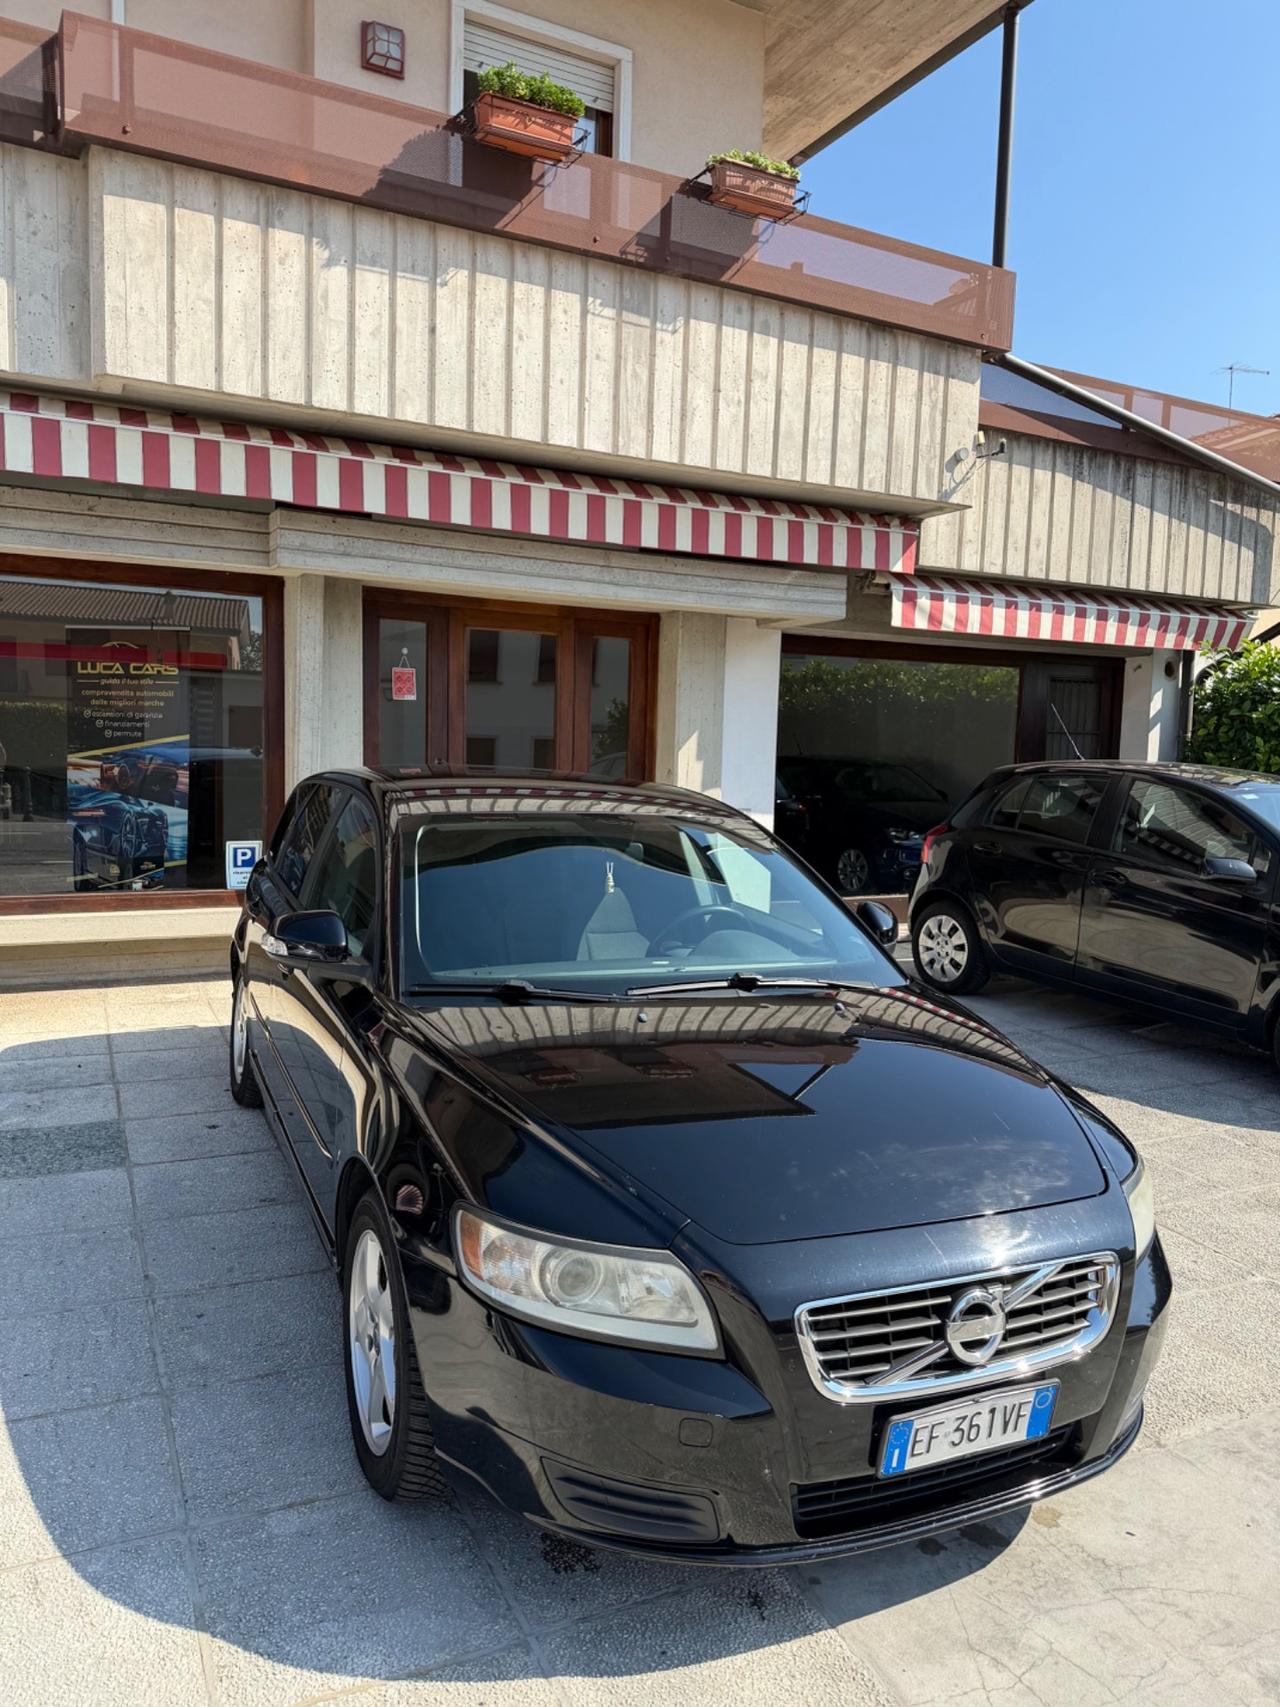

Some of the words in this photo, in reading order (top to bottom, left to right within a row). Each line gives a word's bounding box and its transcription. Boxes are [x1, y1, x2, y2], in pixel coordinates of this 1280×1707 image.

[77, 661, 125, 675] LUCA
[129, 663, 179, 676] CARS
[81, 689, 135, 698] compravendita
[136, 689, 174, 697] automobili
[109, 698, 137, 708] migliori
[137, 699, 165, 707] marche
[134, 712, 163, 720] garanzia
[104, 720, 150, 729] finanziamenti
[236, 848, 252, 867] P
[910, 1420, 945, 1458] EF
